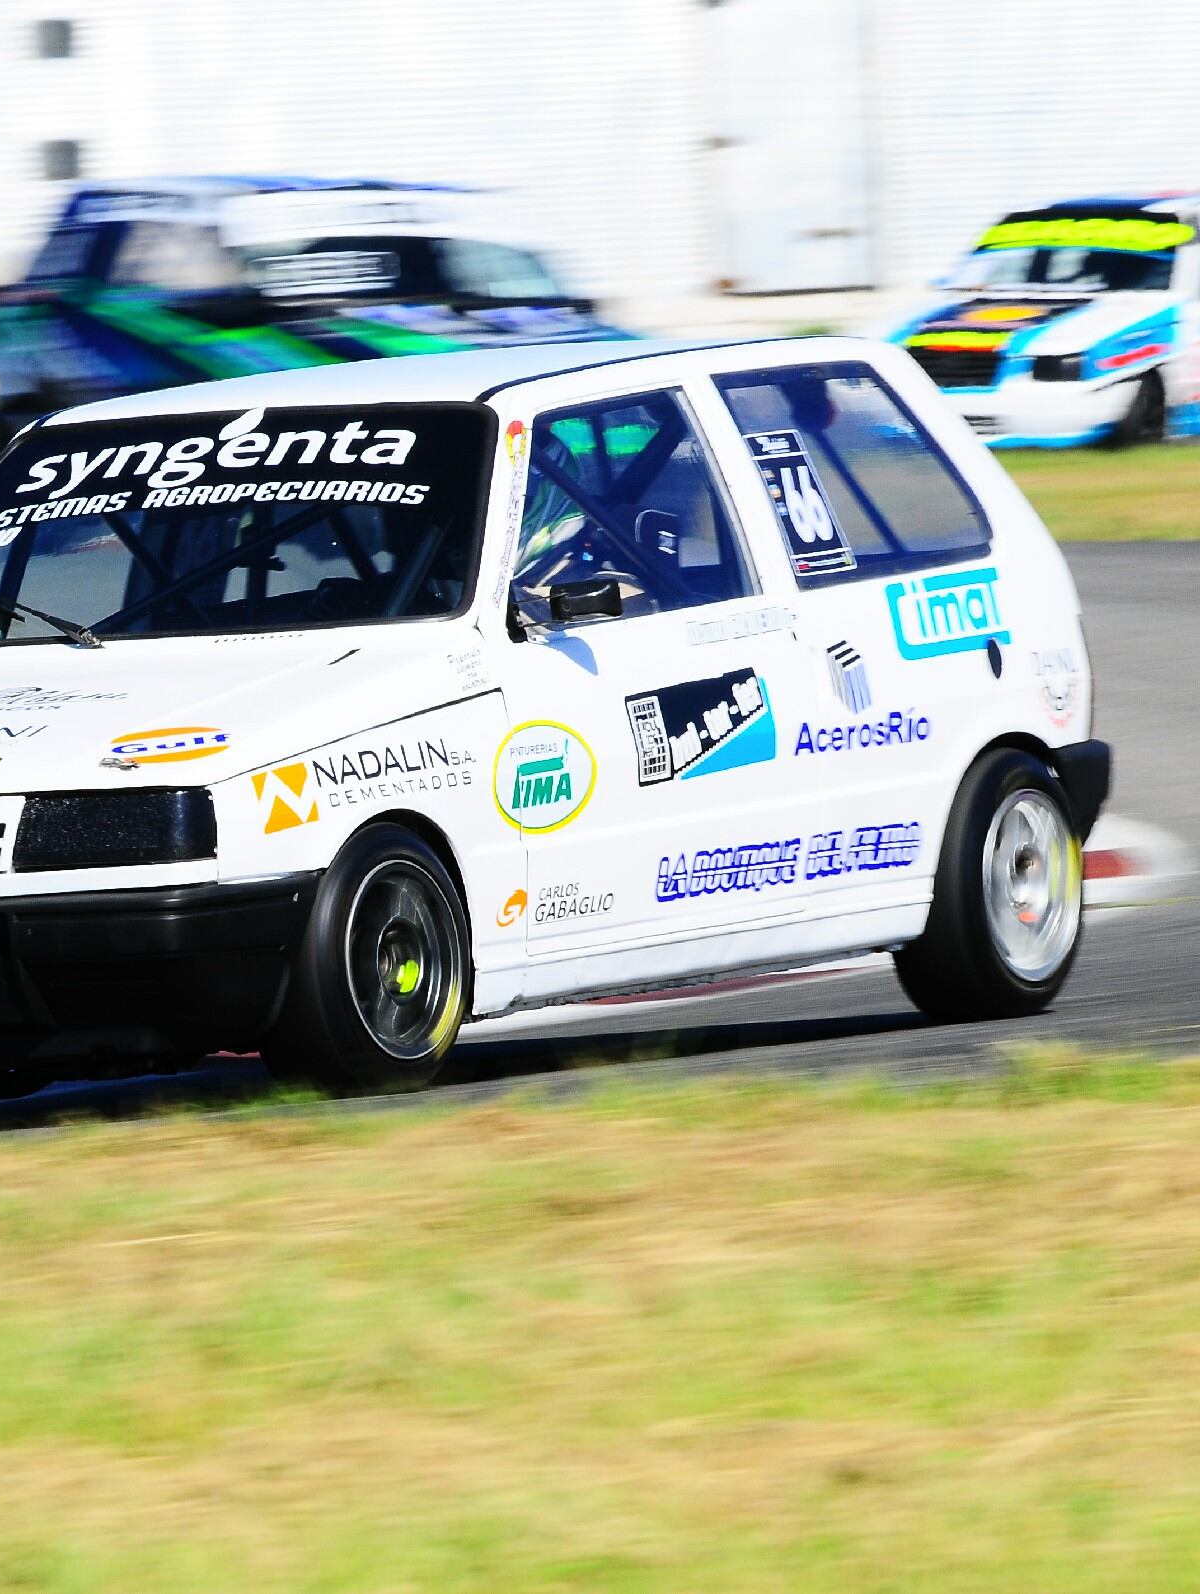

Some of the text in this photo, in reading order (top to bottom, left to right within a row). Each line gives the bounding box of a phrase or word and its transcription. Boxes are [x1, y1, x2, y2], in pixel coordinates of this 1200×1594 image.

[16, 407, 417, 498] syngenta
[141, 480, 431, 509] AGROPECUARIOS
[111, 733, 231, 753] Gulf
[312, 738, 477, 787] NADALIN S.A.
[328, 771, 472, 807] CEMENTADOS
[538, 882, 580, 901] CARLOS
[657, 852, 688, 902] LA
[534, 892, 615, 922] GABAGLIO
